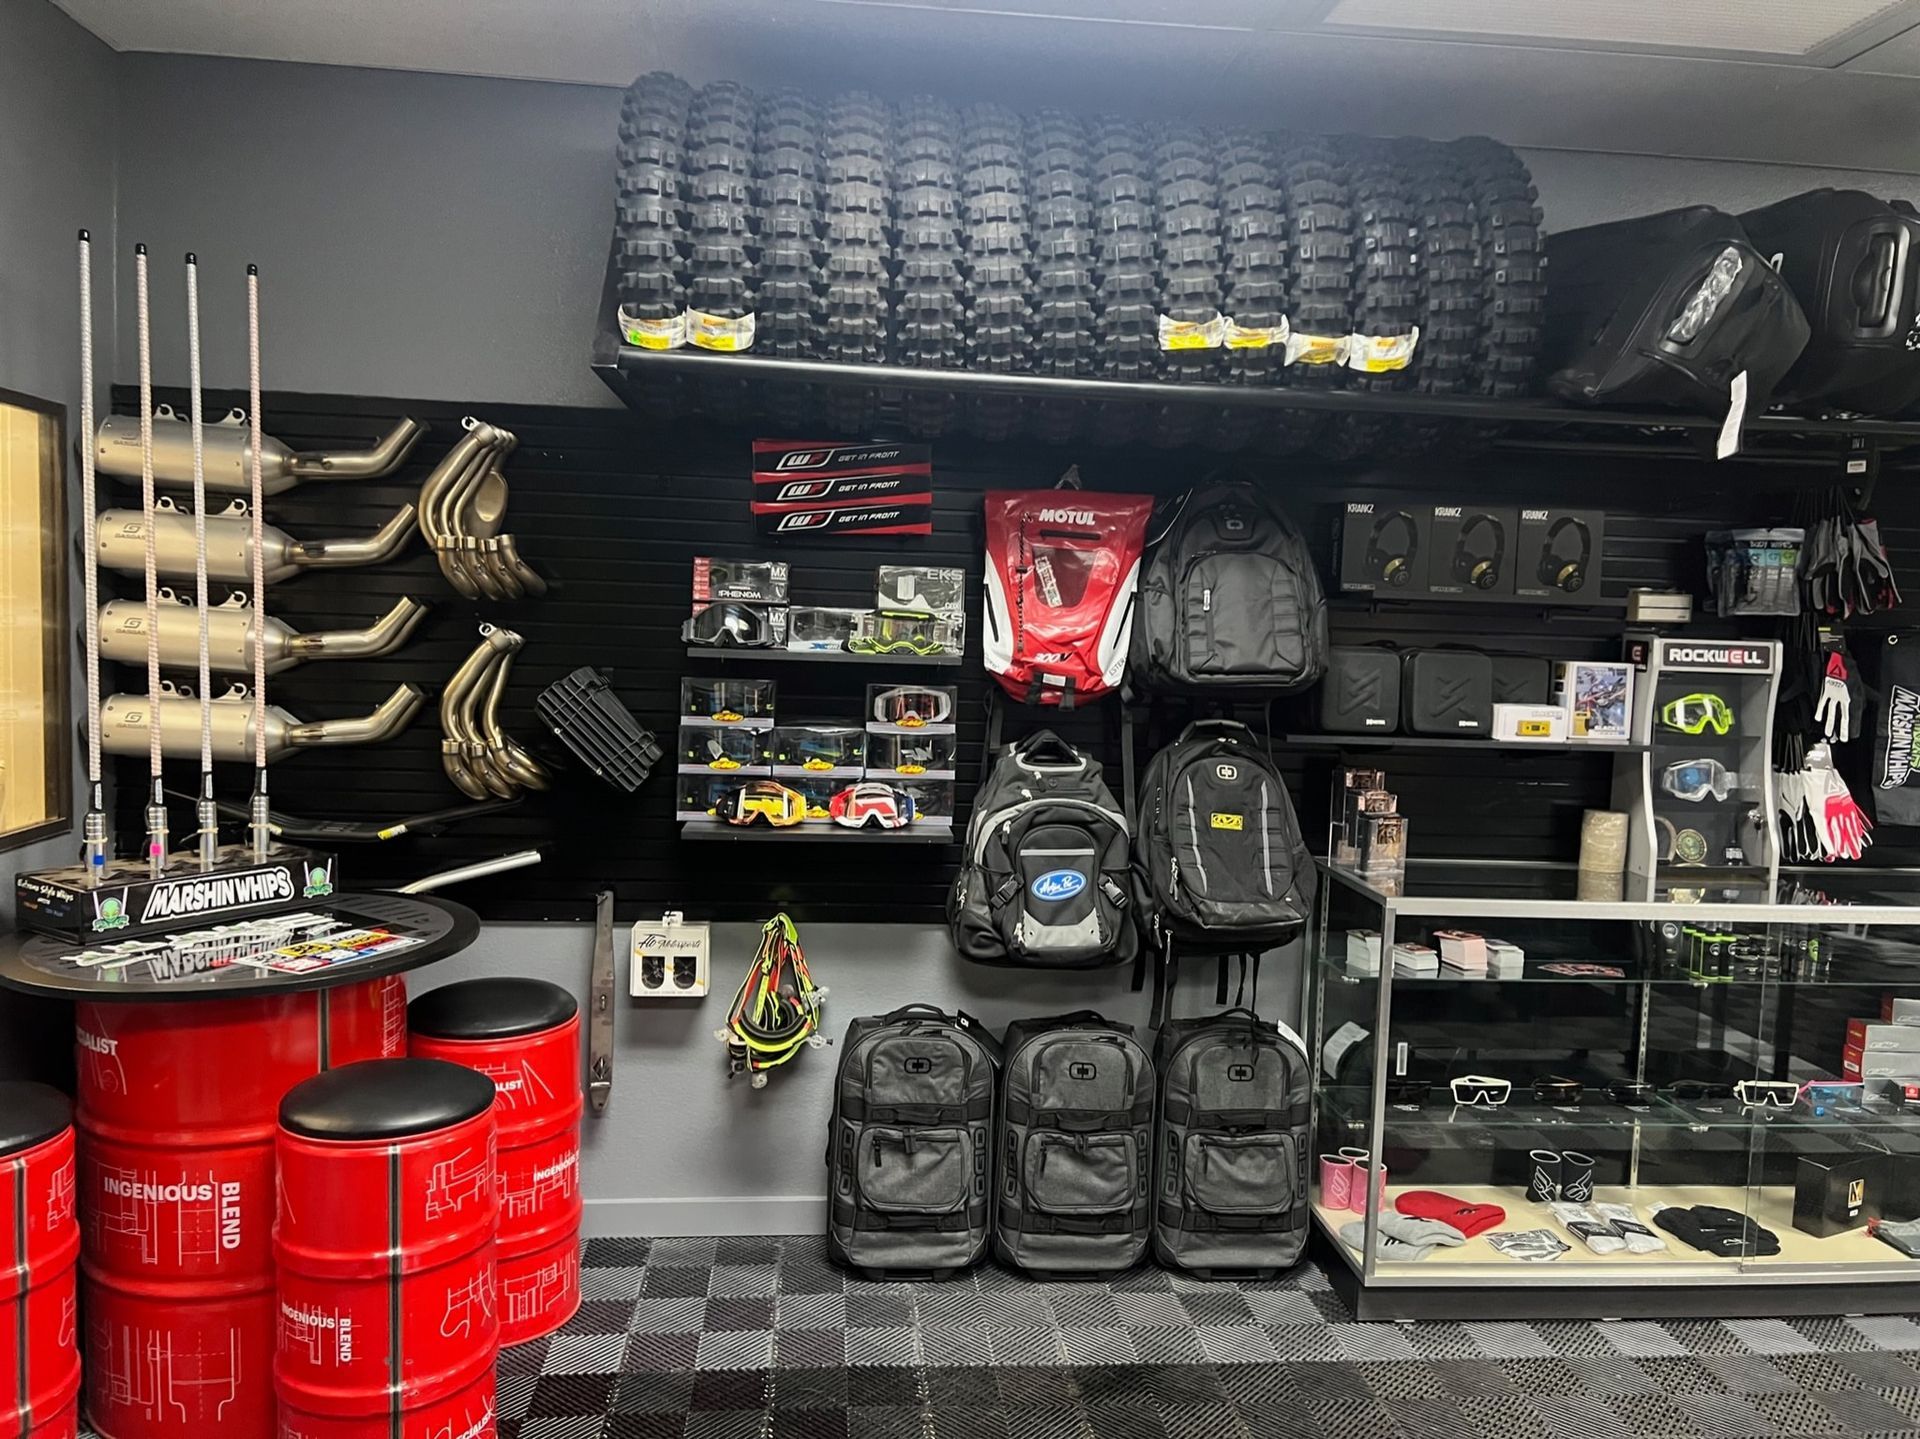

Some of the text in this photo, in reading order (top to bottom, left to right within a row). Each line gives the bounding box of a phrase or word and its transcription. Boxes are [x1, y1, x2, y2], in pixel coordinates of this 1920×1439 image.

[838, 455, 855, 463] GET
[869, 451, 900, 460] FRONT
[838, 484, 856, 492] GET
[858, 482, 868, 490] IN
[869, 481, 900, 489] FRONT
[838, 515, 856, 523] GET
[858, 513, 868, 521] IN
[869, 512, 900, 520] FRONT
[1039, 508, 1095, 525] MOTUL
[770, 566, 786, 577] MX
[927, 569, 962, 581] EKS
[769, 612, 785, 623] MX
[1669, 648, 1762, 664] ROCKWELL
[104, 1177, 213, 1202] INGENIOUS
[222, 1182, 241, 1249] BLEND
[282, 1302, 335, 1329] INGENIOUS
[340, 1318, 351, 1362] BLEND
